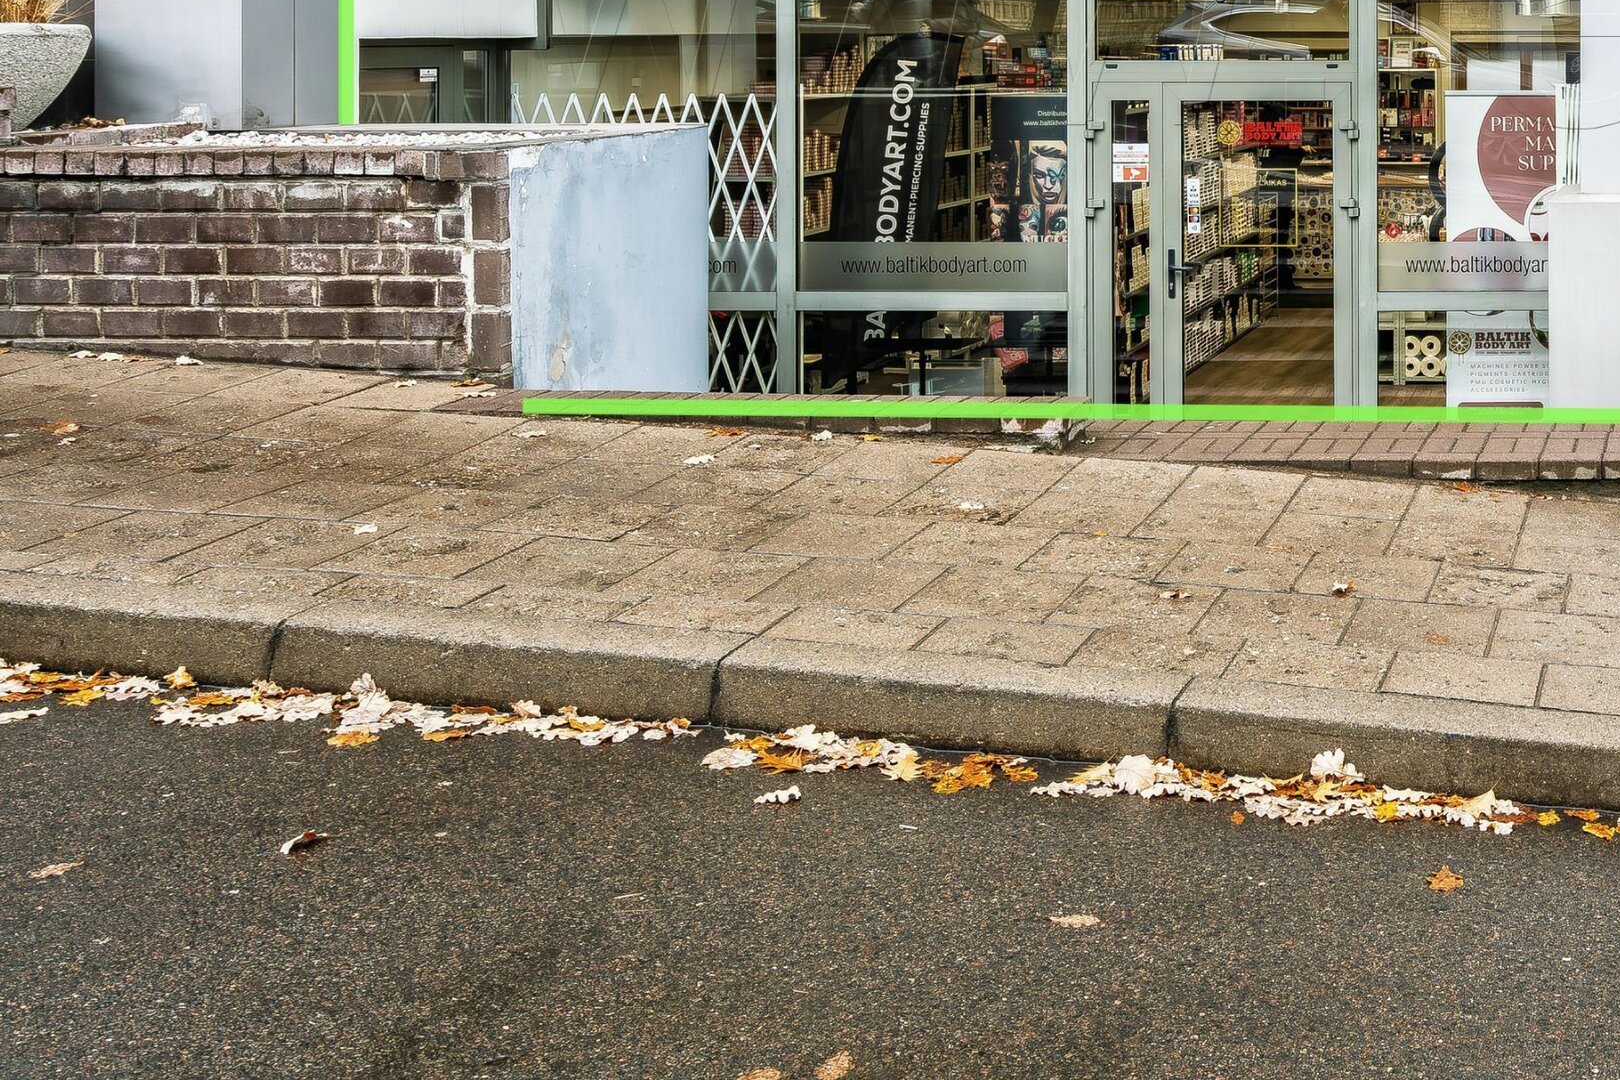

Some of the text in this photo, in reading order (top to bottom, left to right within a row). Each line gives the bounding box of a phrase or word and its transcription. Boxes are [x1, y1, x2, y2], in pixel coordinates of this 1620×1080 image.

[1244, 121, 1303, 132] BALTIK
[1244, 131, 1303, 141] BODY ART
[841, 255, 1028, 278] www.baltikbodyart.com
[1474, 331, 1531, 342] BALTIK
[1474, 341, 1531, 350] BODY ART
